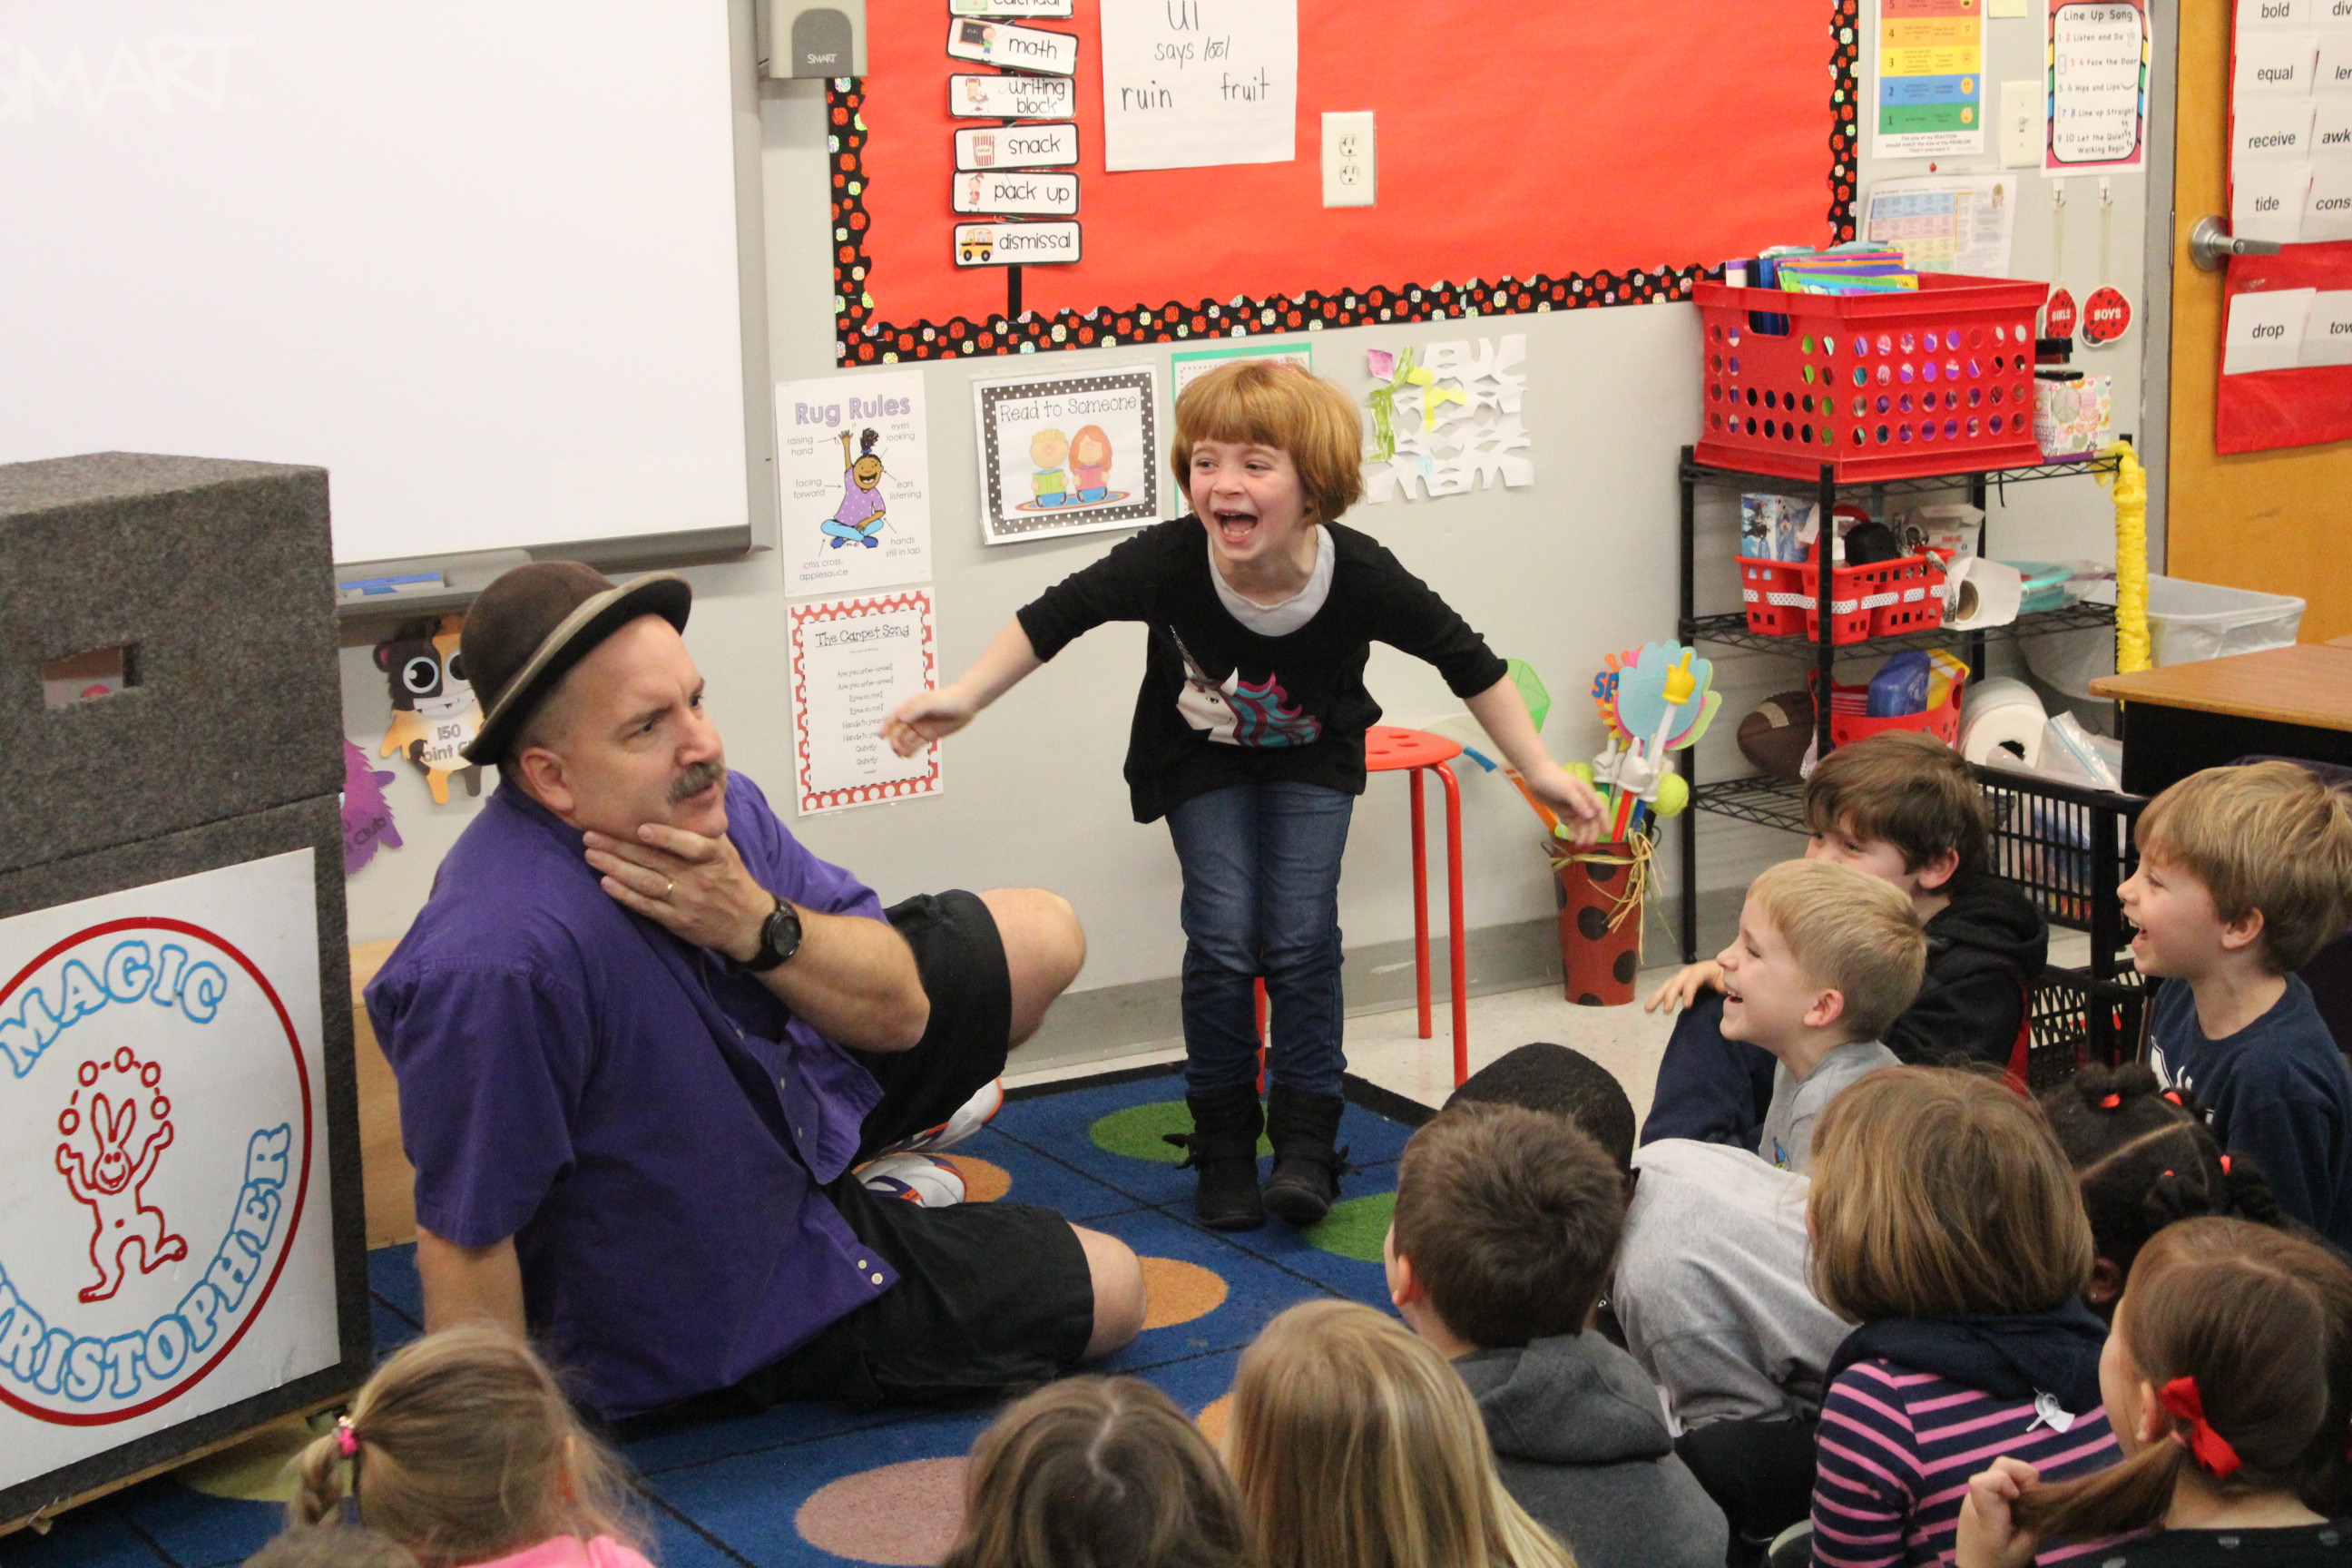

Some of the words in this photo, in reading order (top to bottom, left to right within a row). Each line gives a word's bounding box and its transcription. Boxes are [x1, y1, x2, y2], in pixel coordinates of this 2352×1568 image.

[2064, 11, 2085, 22] Line
[2091, 10, 2104, 23] Up
[2110, 9, 2133, 23] Song
[2261, 4, 2289, 19] bold
[1888, 28, 1895, 38] 4
[2065, 33, 2071, 42] 2
[2073, 34, 2095, 42] Listen
[1008, 37, 1057, 60] math
[807, 53, 838, 64] SMART
[1154, 42, 1194, 70] says
[1889, 57, 1895, 67] 3
[2087, 58, 2103, 67] Face
[2121, 57, 2138, 65] Door
[0, 34, 258, 121] MART
[2257, 64, 2294, 83] equal
[1008, 78, 1065, 101] writing
[1220, 66, 1270, 103] fruit
[1888, 86, 1894, 96] 2
[1121, 80, 1172, 112] ruin
[1016, 97, 1057, 114] block
[2078, 109, 2093, 117] Line
[2095, 110, 2103, 118] up
[2106, 107, 2134, 117] Straight
[1888, 115, 1893, 125] 1
[1008, 132, 1061, 154] snack
[2249, 131, 2296, 148] receive
[2322, 129, 2351, 144] awk
[2077, 145, 2105, 154] Walking
[995, 180, 1037, 201] pack
[1046, 186, 1070, 204] up
[2255, 196, 2279, 211] tide
[2316, 197, 2352, 211] cons
[999, 231, 1071, 250] dismissal
[2052, 309, 2071, 322] GIRLS
[2094, 308, 2122, 321] BOYS
[2251, 323, 2284, 339] drop
[795, 402, 841, 427] Rug
[848, 394, 911, 420] Rules
[999, 400, 1040, 422] Read
[1044, 400, 1063, 417] to
[1068, 395, 1137, 415] Someone
[891, 421, 909, 431] eyes
[787, 436, 814, 446] raising
[887, 431, 916, 443] looking
[791, 446, 814, 456] hand
[796, 478, 822, 489] facing
[897, 480, 914, 489] ears
[794, 488, 825, 499] forward
[889, 489, 922, 501] listening
[891, 535, 915, 545] hands
[886, 547, 898, 558] still
[900, 547, 906, 557] in
[907, 546, 921, 557] lap
[803, 559, 820, 570] criss
[799, 567, 848, 582] applesauce
[815, 631, 838, 646] The
[839, 626, 880, 642] Carpet
[882, 624, 909, 638] Song
[437, 723, 462, 740] 150
[423, 744, 454, 762] oint
[0, 939, 228, 1080] MAGIC
[0, 1121, 291, 1403] RISTOPHER
